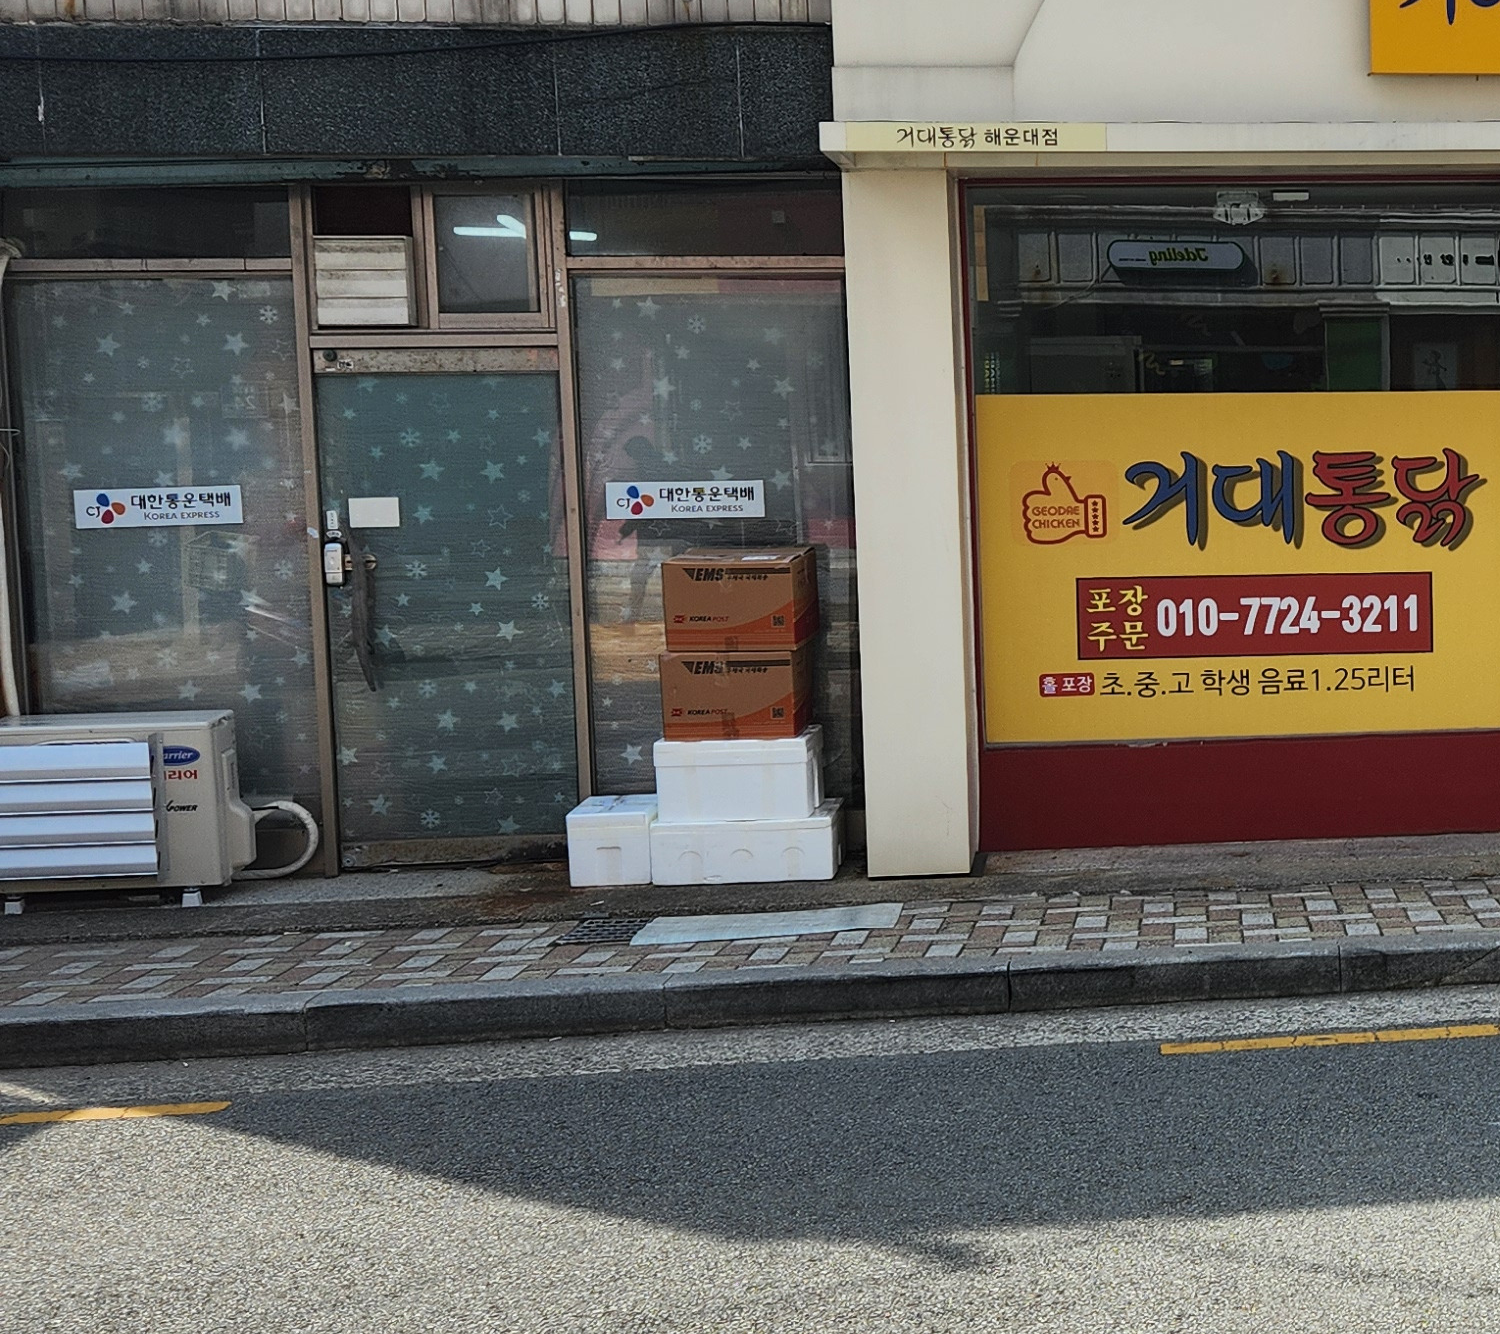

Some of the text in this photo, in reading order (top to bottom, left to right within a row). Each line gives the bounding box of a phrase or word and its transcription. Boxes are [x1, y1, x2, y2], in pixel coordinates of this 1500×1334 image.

[896, 126, 1059, 149] 거대통닭 해운대점
[617, 497, 630, 509] CJ
[1123, 448, 1479, 547] 거대통닭
[86, 506, 101, 518] CJ
[144, 510, 220, 520] KOREA EXPRESS
[671, 504, 744, 513] KOREA EXPRESS
[1031, 505, 1080, 517] GEODAE
[1031, 518, 1080, 529] CHICKEN
[695, 567, 724, 581] EMS
[1086, 585, 1148, 616] 포장
[689, 615, 712, 623] KOREA
[1156, 593, 1418, 637] 010-7724-3211
[1086, 621, 1148, 652] 주문
[694, 660, 723, 675] EMS
[1042, 676, 1093, 694] 홀 포장
[1100, 671, 1194, 698] 초.중.고
[1200, 668, 1251, 696] 학생
[687, 708, 710, 716] KOREA
[163, 750, 193, 759] arrier
